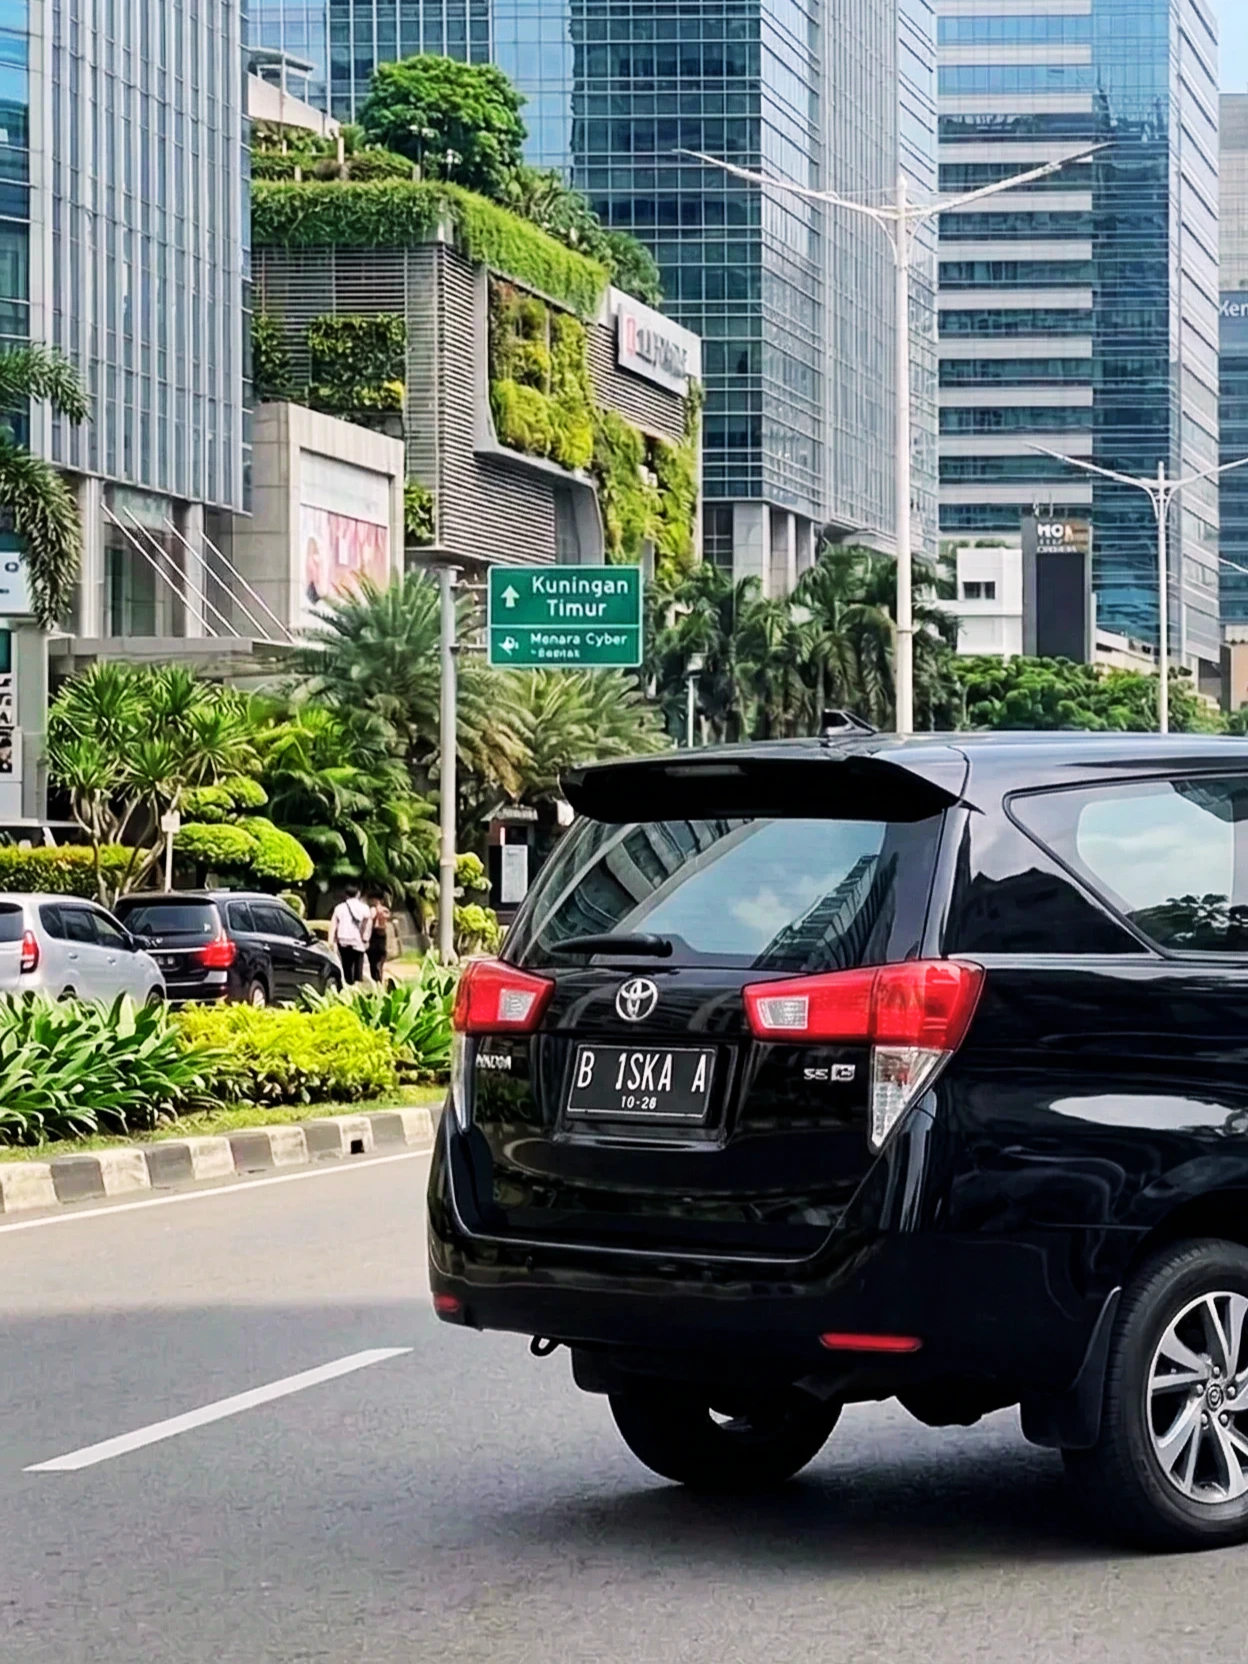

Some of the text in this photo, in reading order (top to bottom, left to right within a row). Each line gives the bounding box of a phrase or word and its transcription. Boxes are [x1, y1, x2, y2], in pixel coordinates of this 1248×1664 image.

[532, 576, 629, 598] Kuningan
[546, 599, 608, 617] Timur
[585, 631, 628, 648] Cyber
[577, 1051, 595, 1088] B
[691, 1054, 707, 1093] A
